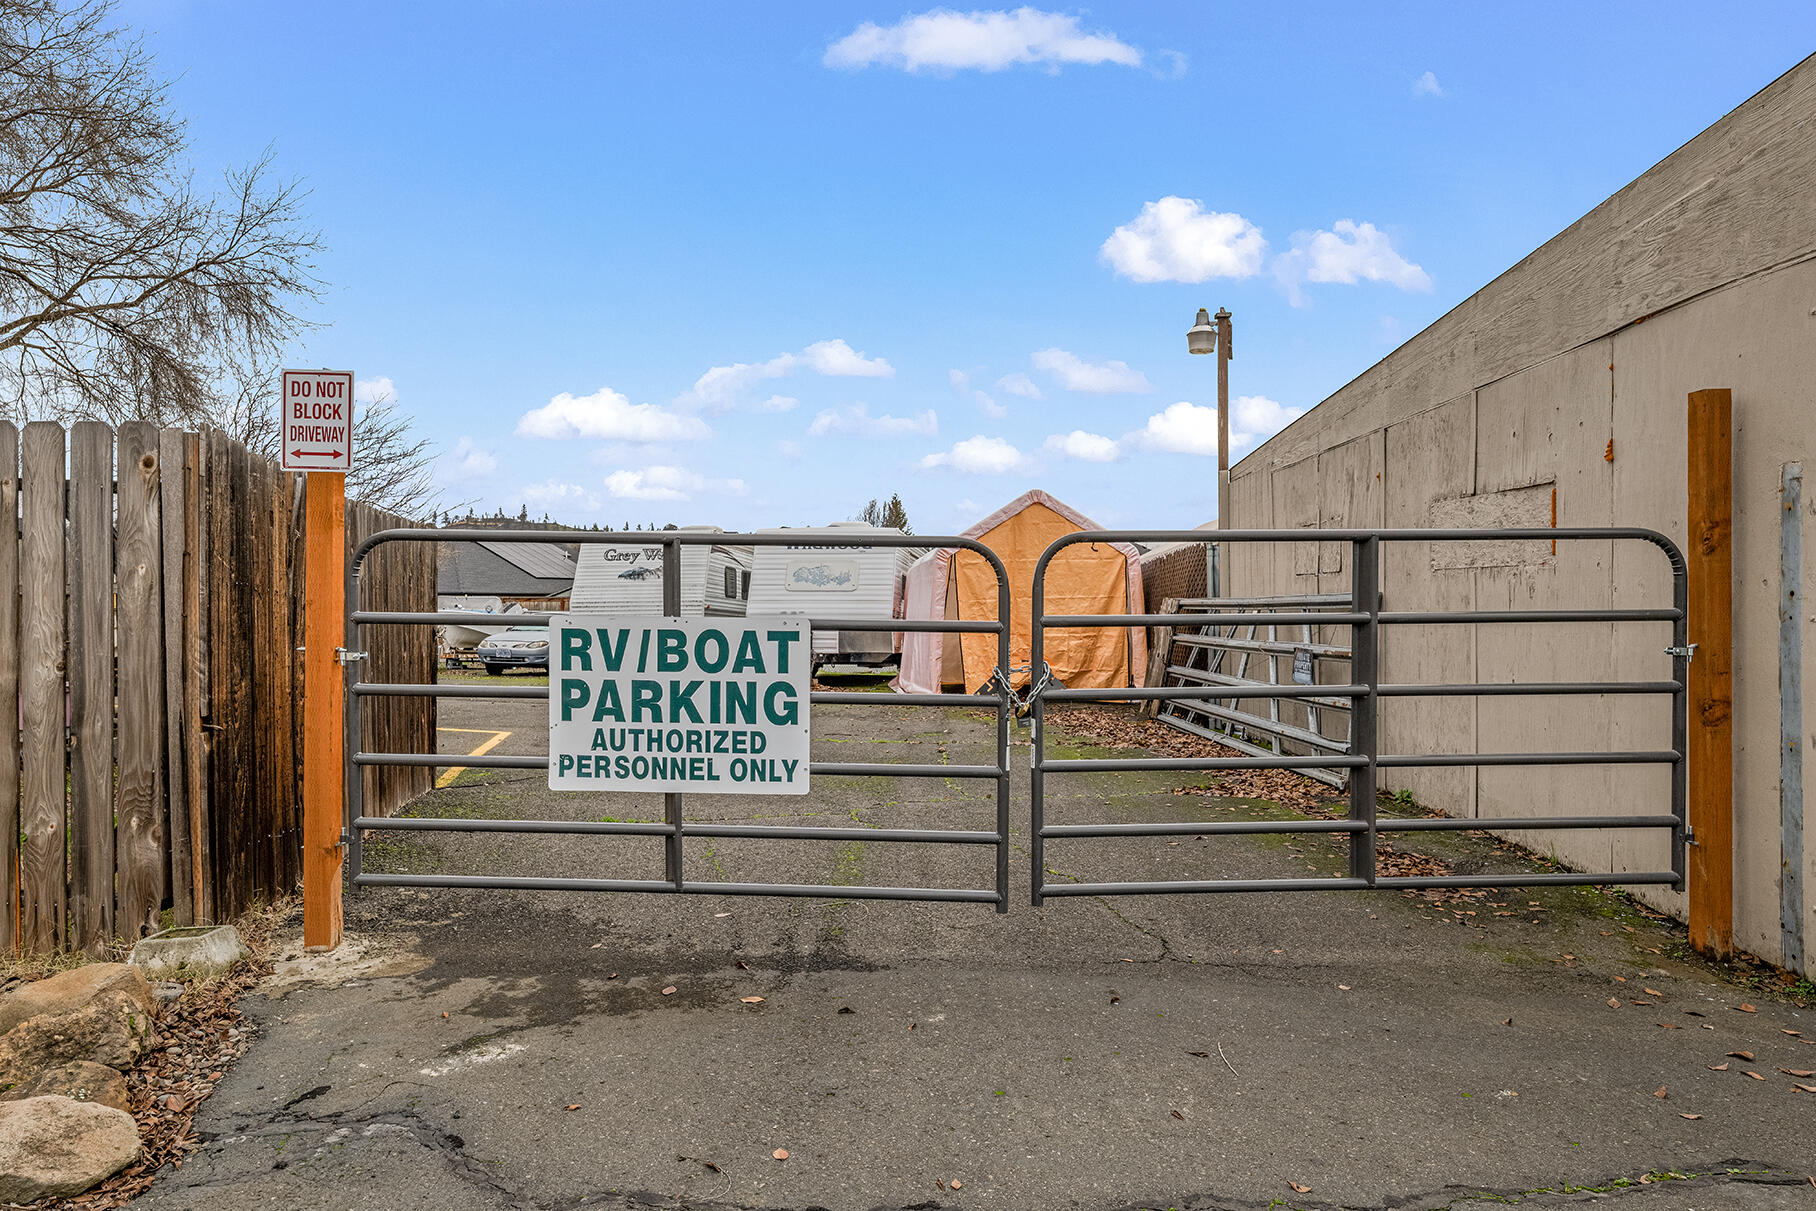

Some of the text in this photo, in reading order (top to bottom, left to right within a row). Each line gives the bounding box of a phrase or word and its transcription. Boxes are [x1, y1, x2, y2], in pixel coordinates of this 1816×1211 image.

[291, 380, 345, 398] DO NOT
[293, 402, 342, 420] BLOCK
[290, 425, 345, 443] DRIVEWAY
[603, 548, 664, 564] Grey Wo
[560, 628, 800, 674] RV/BOAT
[560, 678, 799, 726] PARKING
[590, 727, 767, 754] AUTHORIZED
[558, 754, 799, 783] PERSONNEL ONLY
